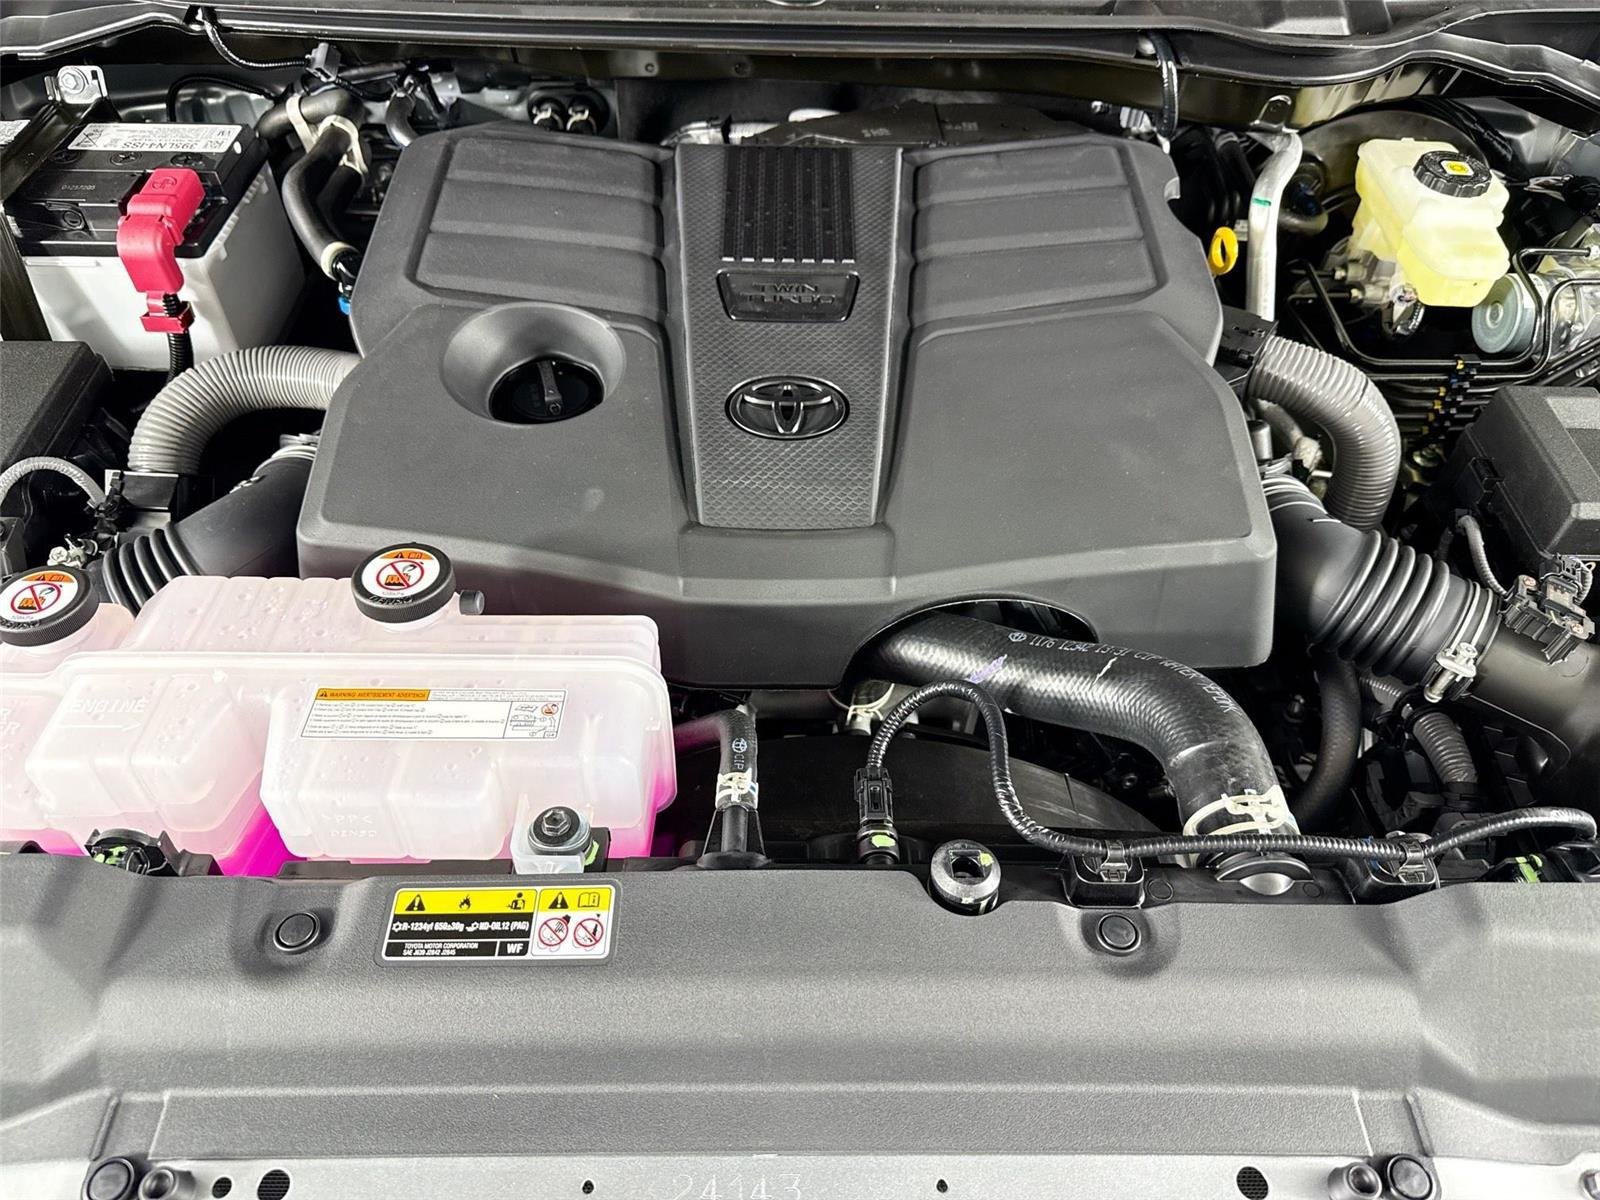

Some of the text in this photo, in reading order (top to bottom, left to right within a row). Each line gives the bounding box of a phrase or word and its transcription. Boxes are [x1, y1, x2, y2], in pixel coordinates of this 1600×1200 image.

[752, 282, 818, 293] TWIN
[71, 697, 149, 713] ENGINE
[734, 754, 745, 770] CIP
[510, 921, 529, 932] (PAG)
[507, 943, 524, 954] WF
